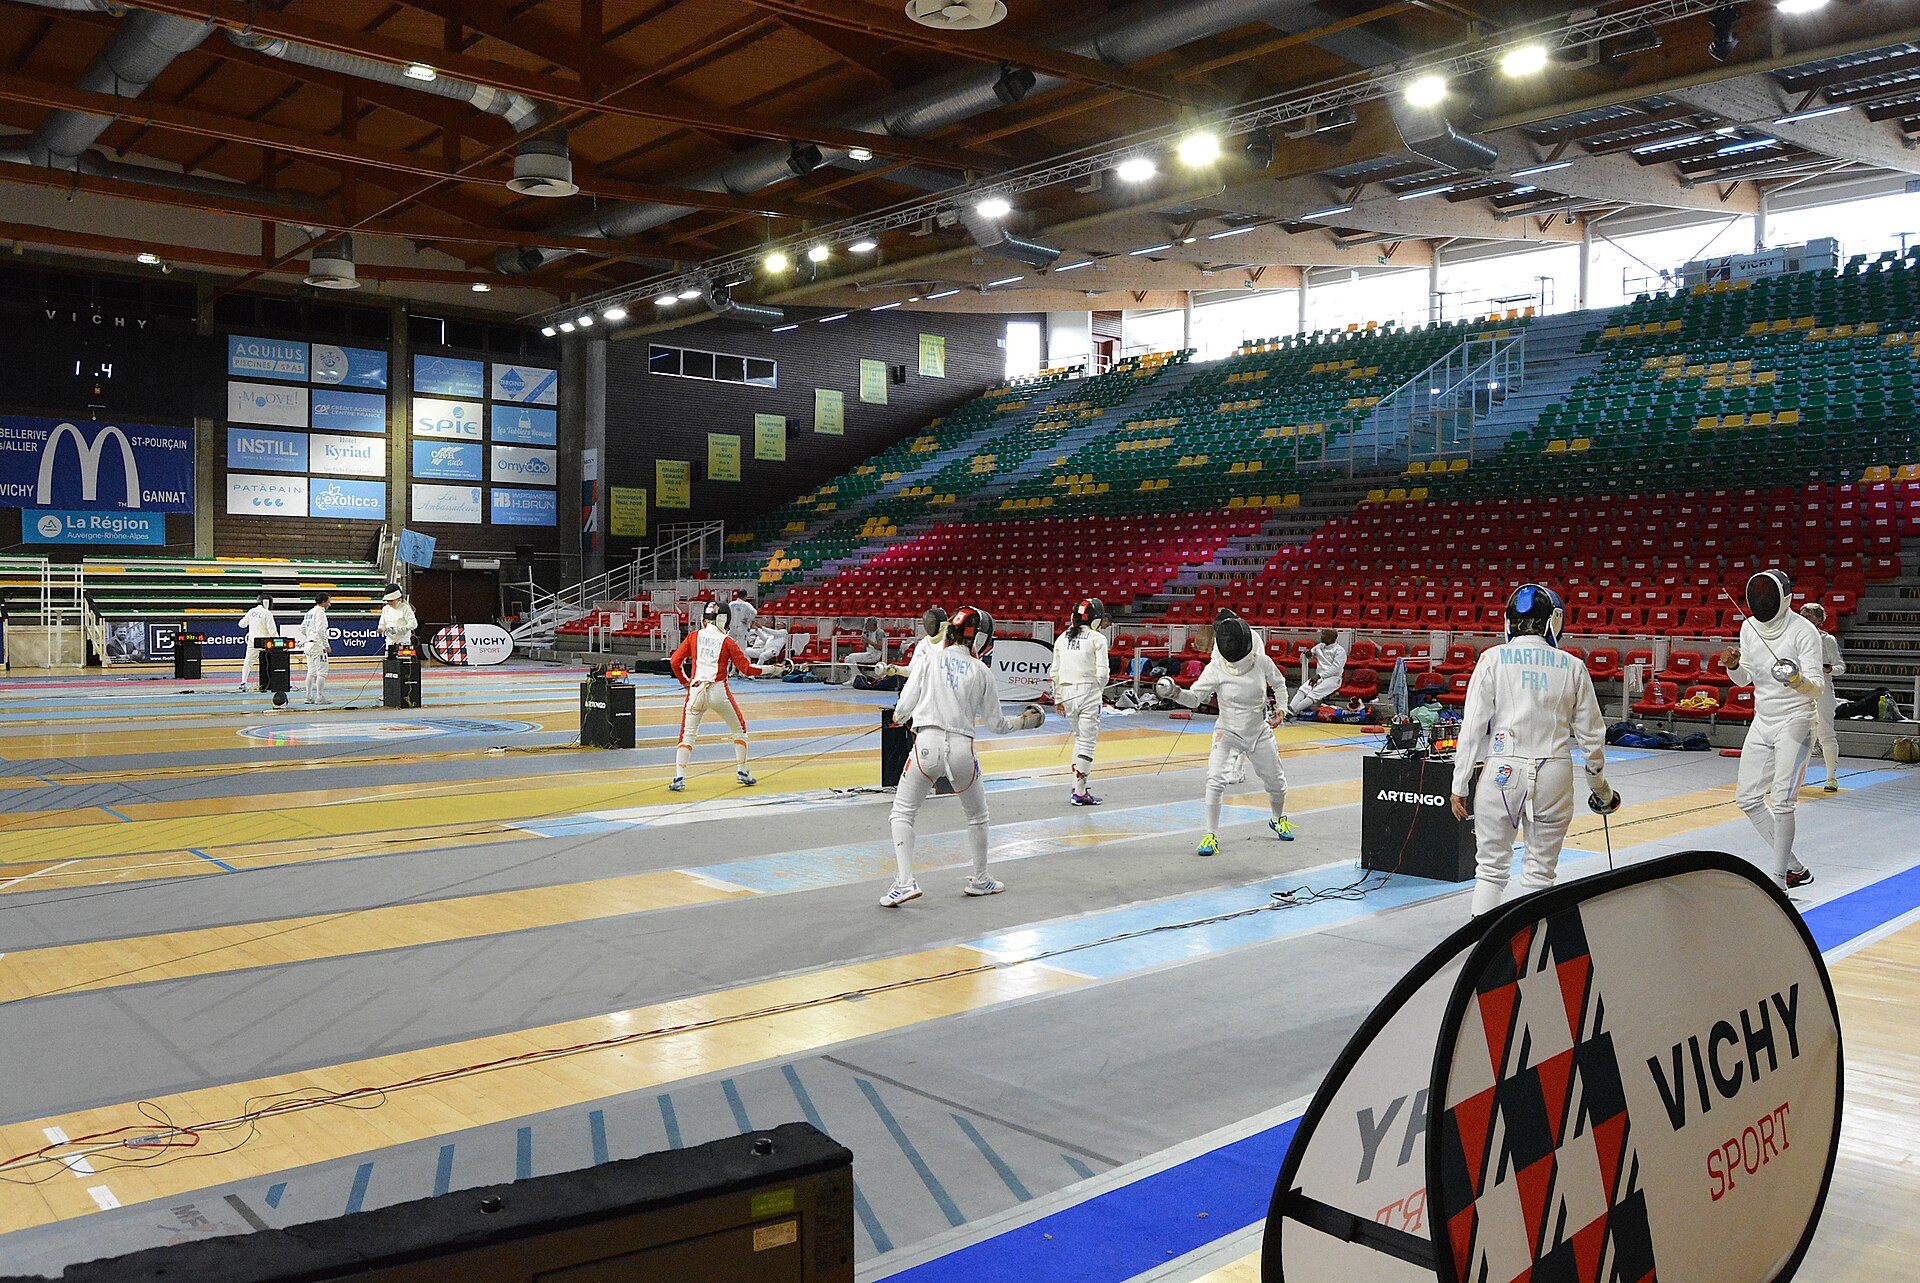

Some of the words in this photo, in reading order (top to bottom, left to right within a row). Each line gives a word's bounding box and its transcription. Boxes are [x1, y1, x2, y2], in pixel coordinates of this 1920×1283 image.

[46, 309, 147, 329] VICHY
[236, 343, 303, 360] AQUILUS
[234, 359, 271, 369] PISCINES
[280, 363, 302, 372] SPAS
[419, 417, 477, 435] SPIE
[0, 428, 47, 440] BELLERIVE
[131, 437, 187, 450] ST-POURÇAIN
[237, 438, 299, 456] INSTILL
[325, 445, 371, 460] Kyriad
[0, 484, 34, 497] VICHY
[143, 490, 187, 504] GANNAT
[512, 500, 555, 510] H.BRUN
[67, 516, 86, 529] La
[90, 515, 149, 531] Région
[67, 531, 149, 541] Auvergne-Rhône-Alpes
[344, 639, 366, 647] Vichy
[1500, 648, 1570, 670] MARTIN.A
[1000, 661, 1052, 675] VICHY
[1008, 677, 1041, 685] SPORT
[1521, 671, 1549, 691] FRA
[1377, 789, 1445, 807] ARTENGO
[1647, 983, 1800, 1131] VICHY
[1707, 1103, 1793, 1201] SPORT
